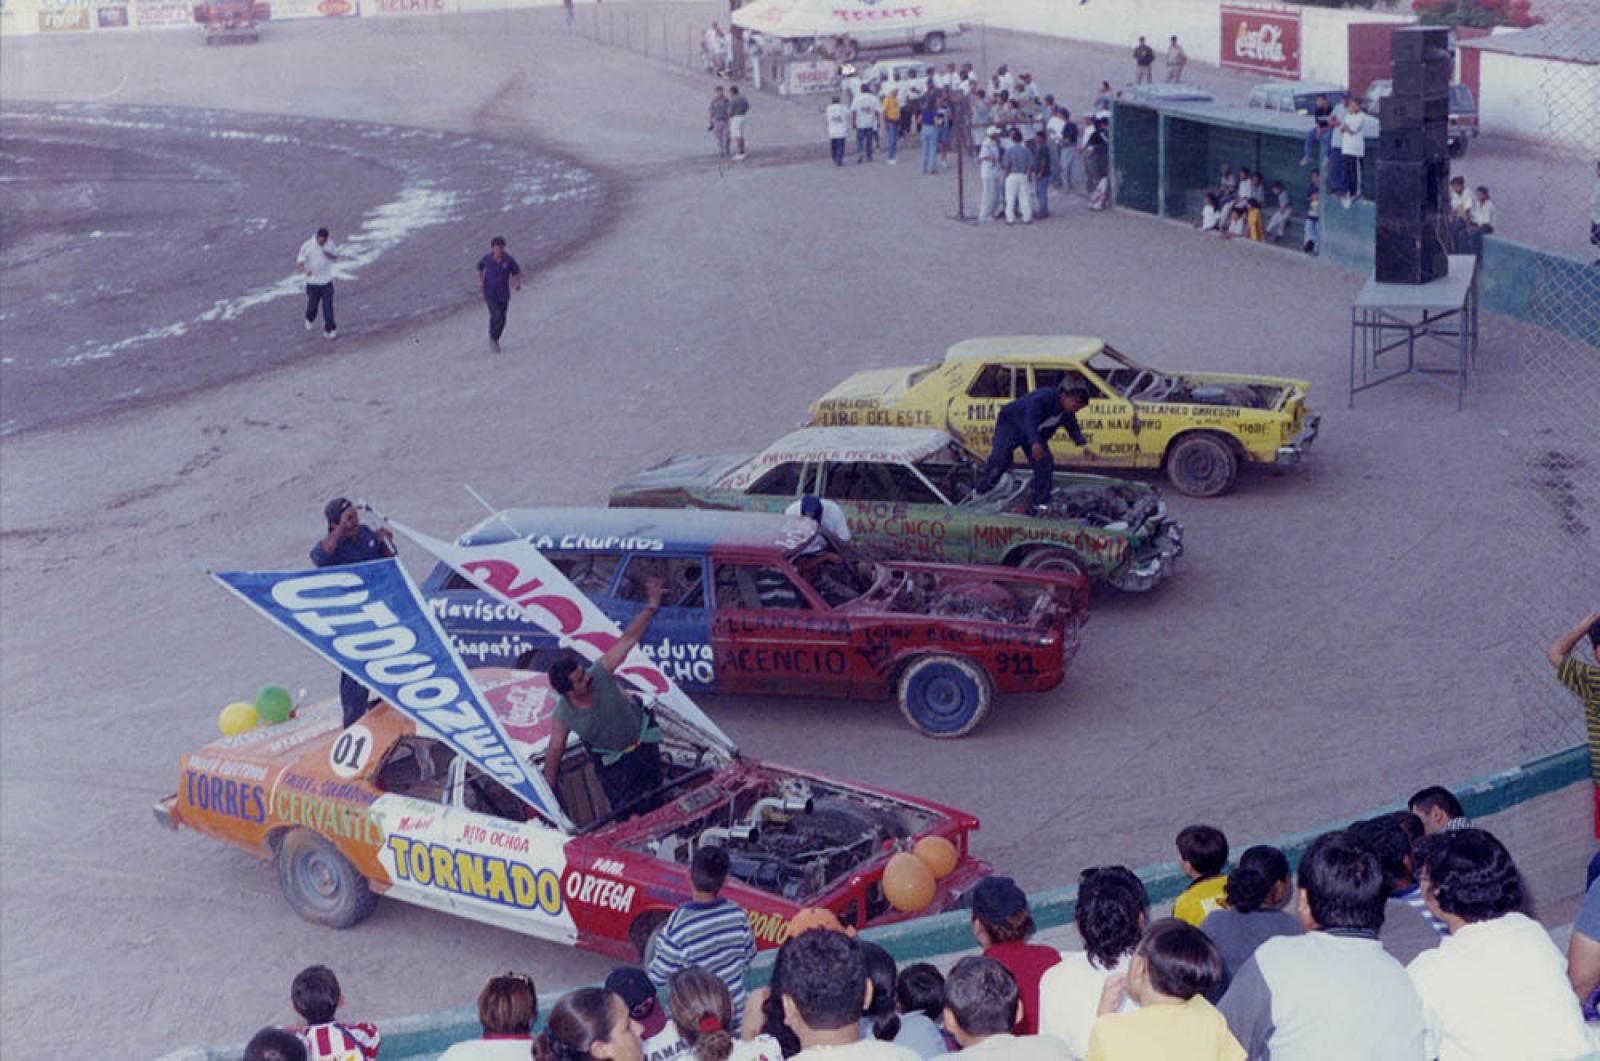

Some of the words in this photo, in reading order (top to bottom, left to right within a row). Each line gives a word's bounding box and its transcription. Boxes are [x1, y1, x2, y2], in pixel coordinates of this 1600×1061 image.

[333, 730, 363, 770] 01
[185, 769, 266, 825] TORRES
[276, 788, 386, 847] CERVANTES
[490, 831, 530, 855] OCHOA
[387, 832, 563, 916] TORNADO
[566, 870, 637, 913] ORTEGA
